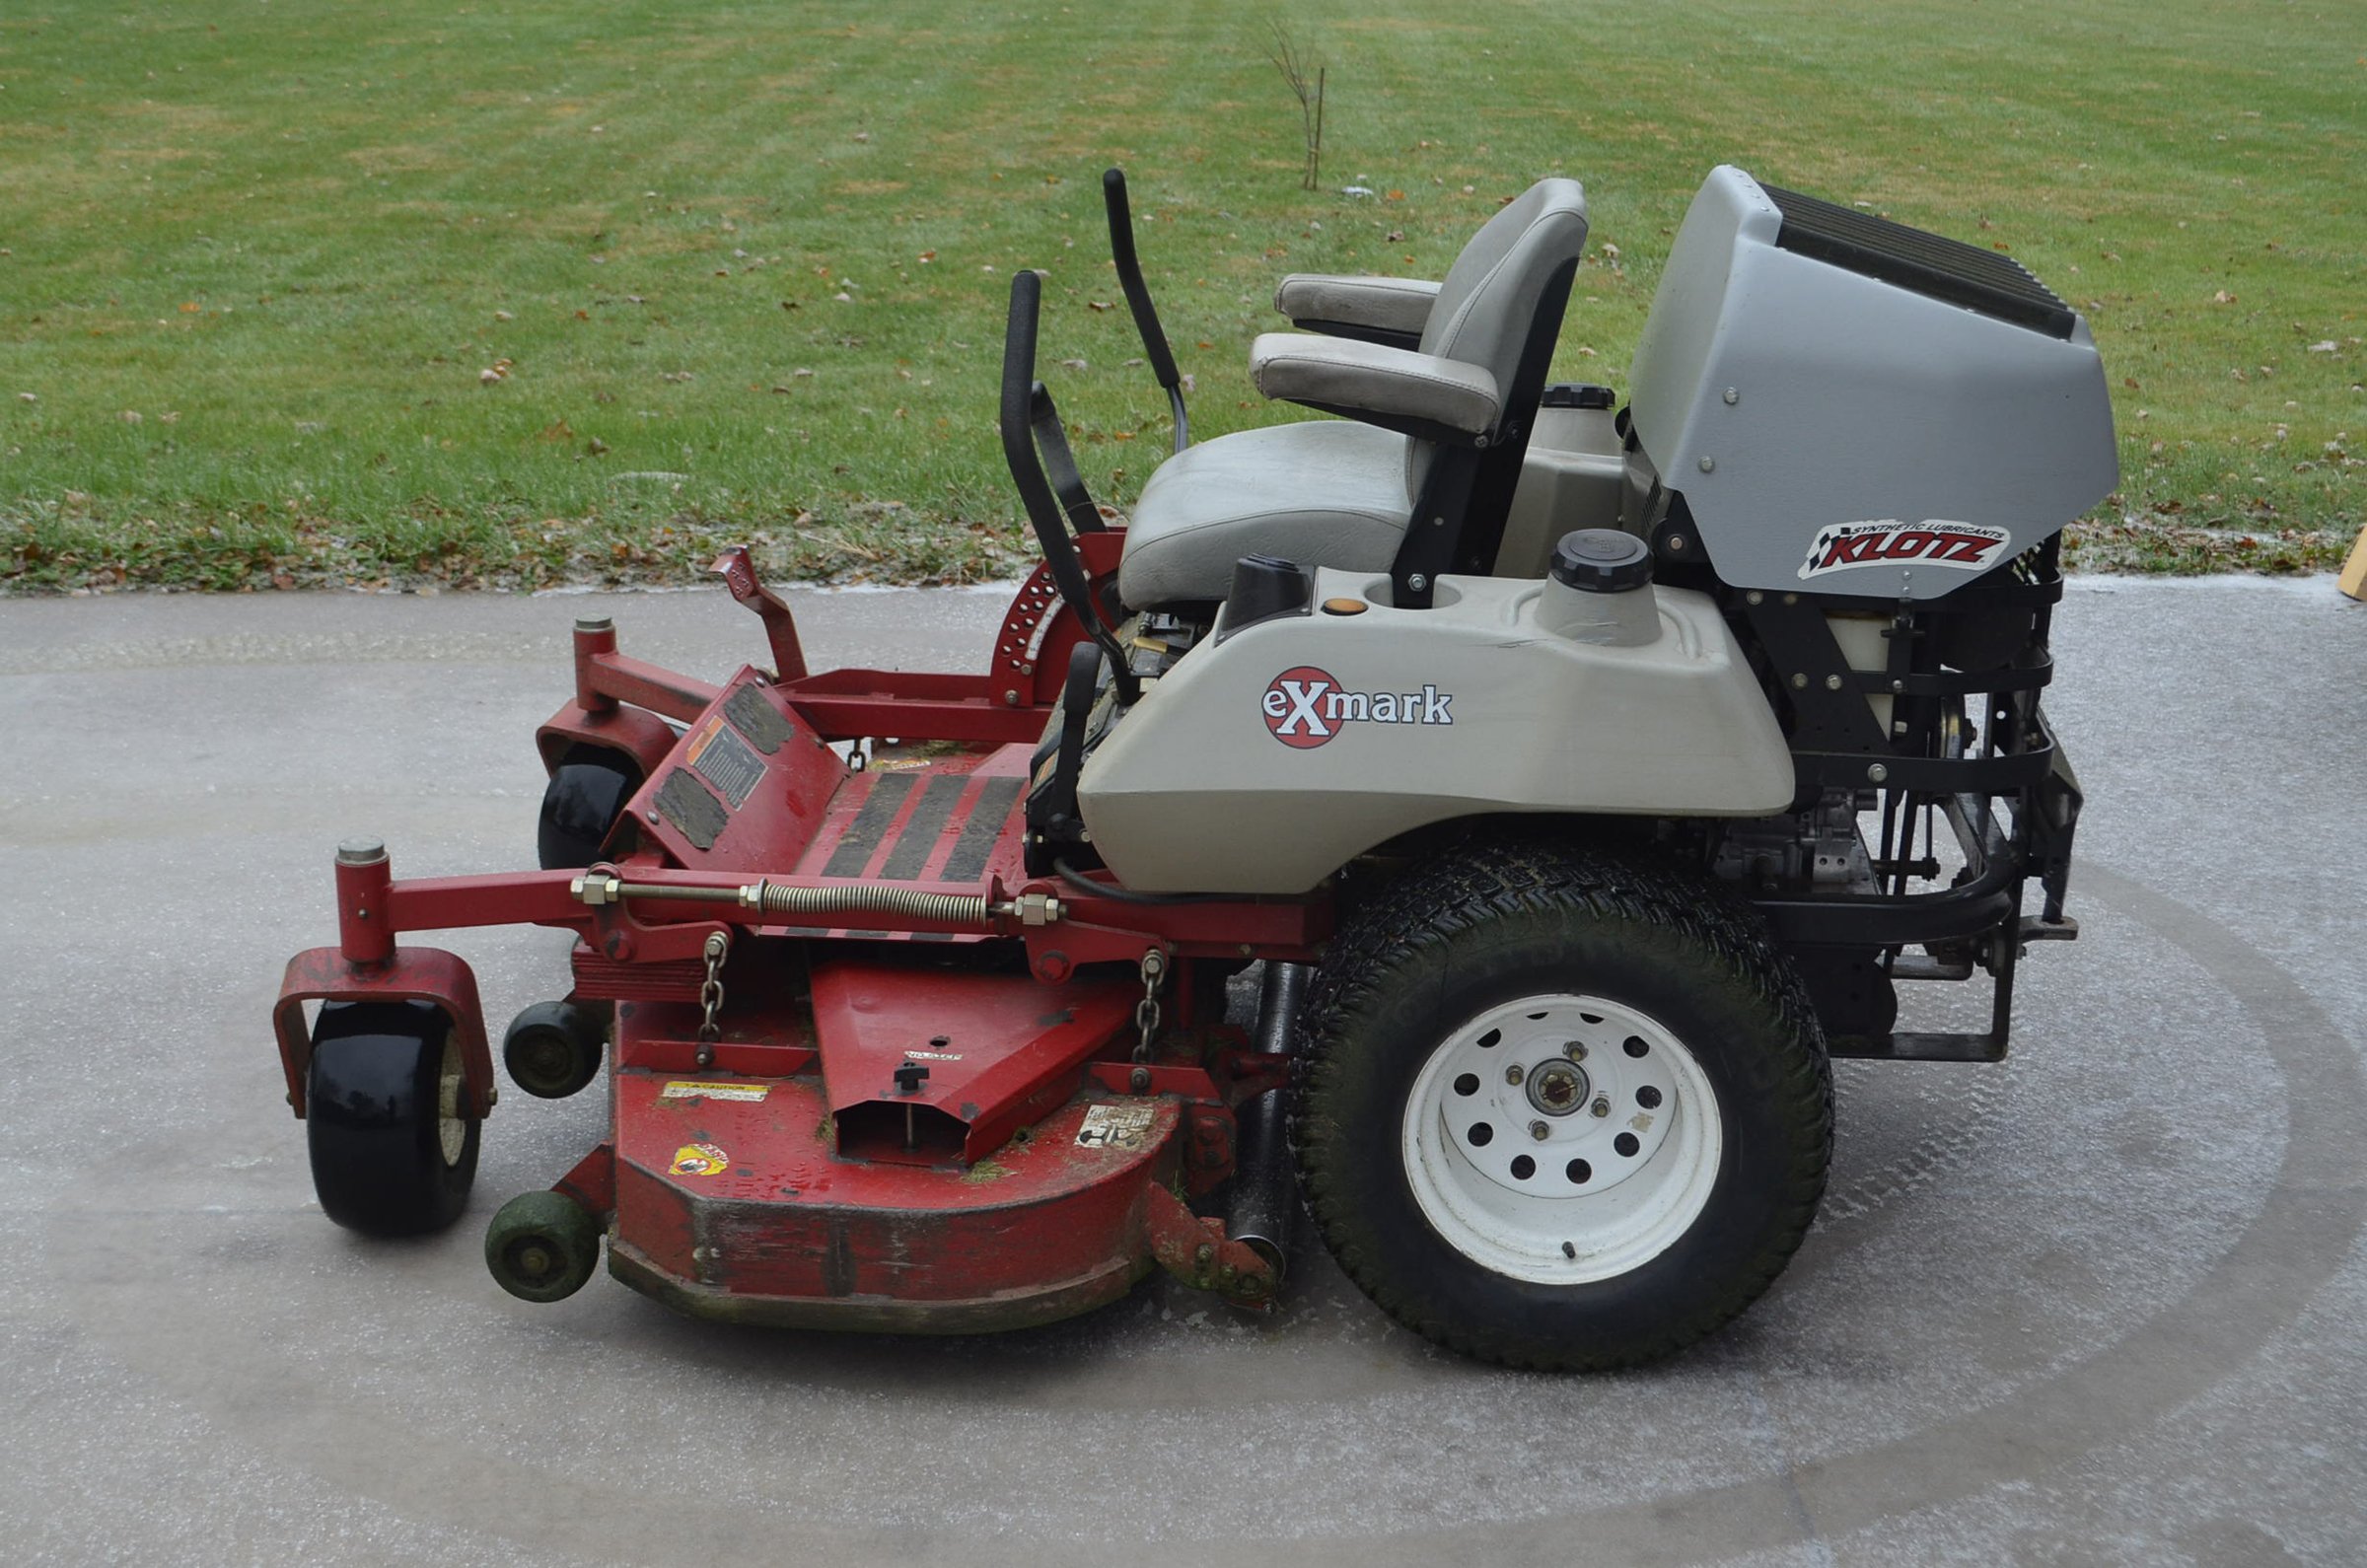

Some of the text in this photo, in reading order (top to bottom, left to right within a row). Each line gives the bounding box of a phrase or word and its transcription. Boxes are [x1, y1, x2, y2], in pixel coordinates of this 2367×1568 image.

[1818, 531, 2004, 569] KLOTZ
[1851, 523, 2005, 539] SYNTHETIC LUBRICANTS
[1261, 679, 1454, 737] eXmark
